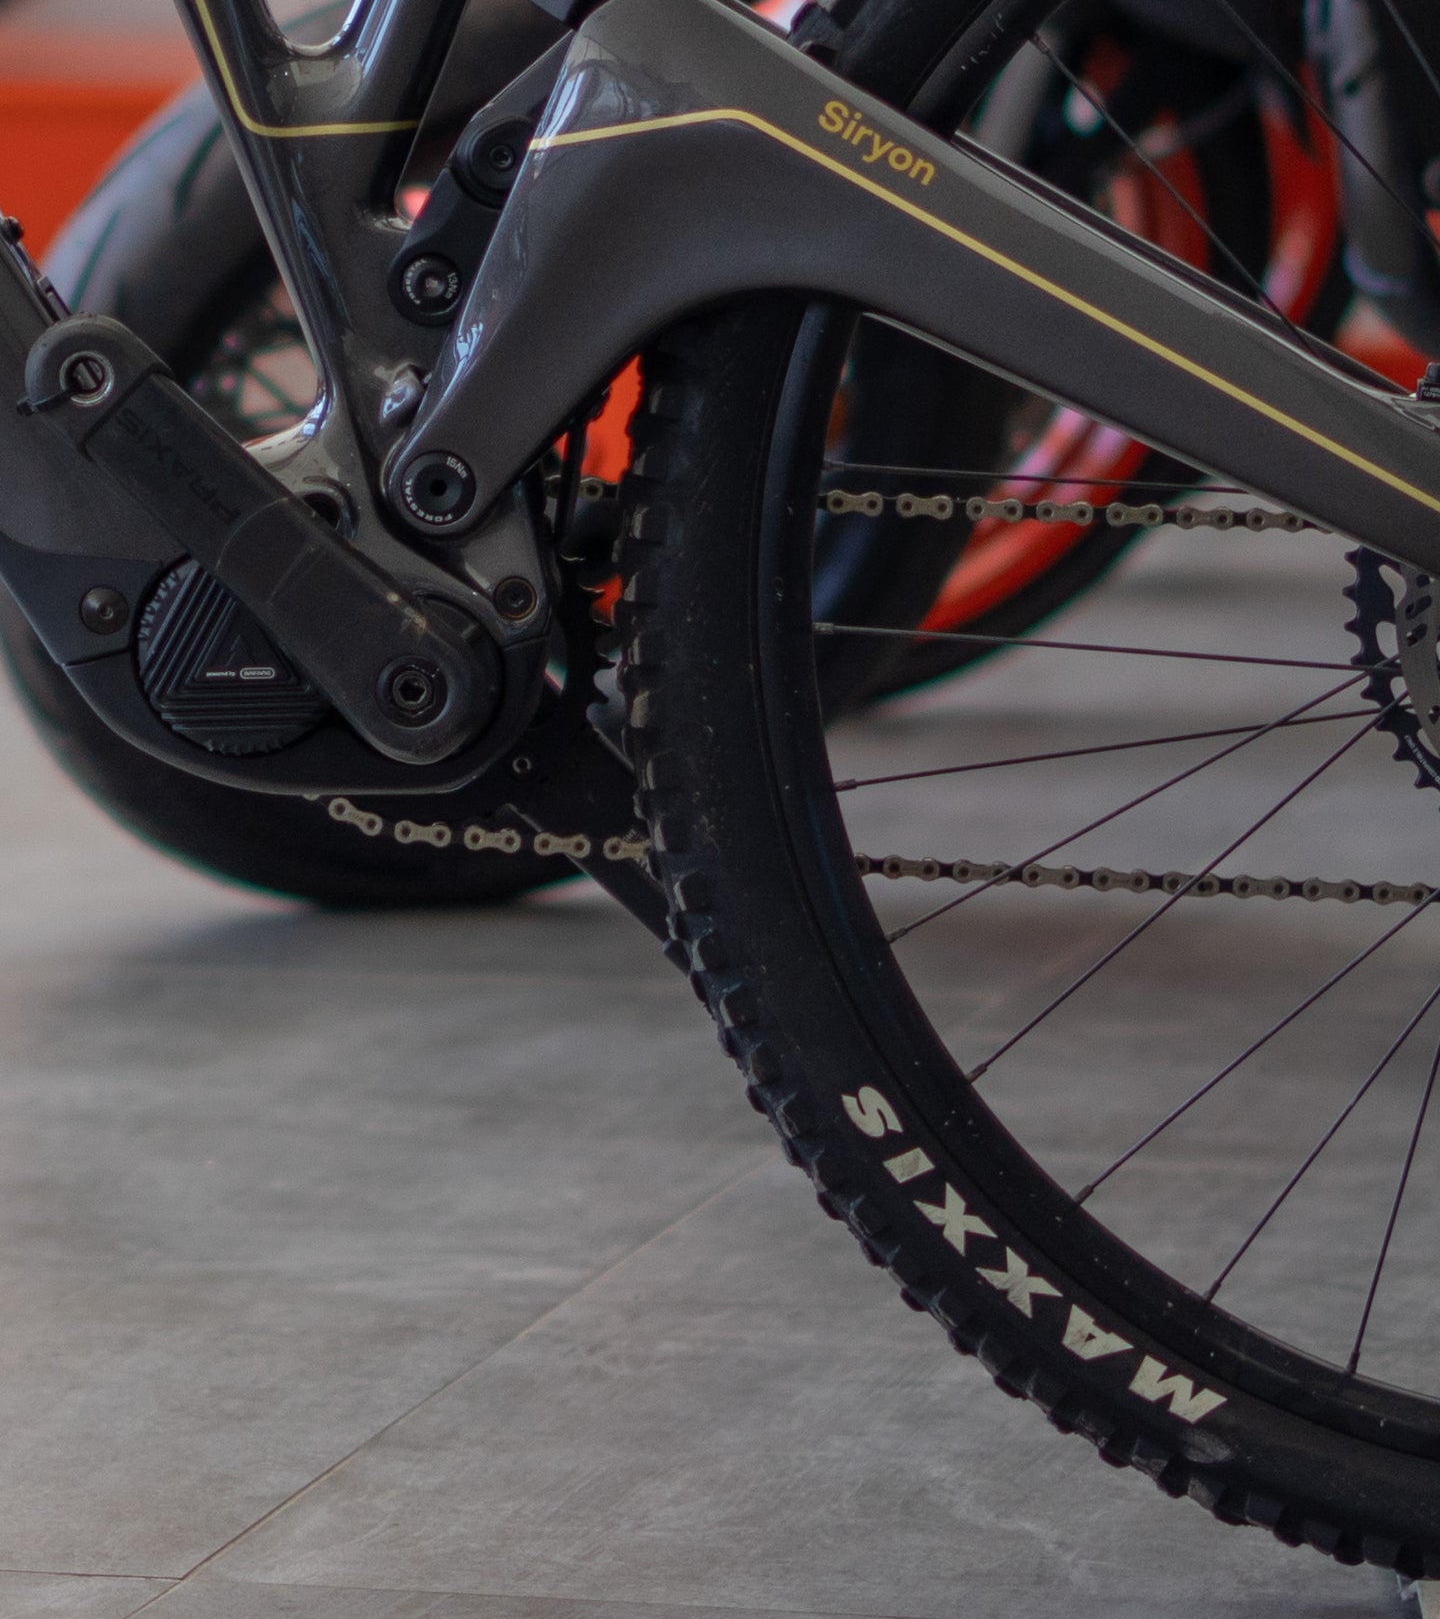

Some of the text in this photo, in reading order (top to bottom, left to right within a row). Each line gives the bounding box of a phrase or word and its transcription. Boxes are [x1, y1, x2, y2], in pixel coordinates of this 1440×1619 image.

[817, 99, 937, 186] Siryon
[115, 407, 242, 526] PRAXIS
[404, 478, 454, 522] FORESTAL
[840, 1084, 1229, 1425] MAXXIS
